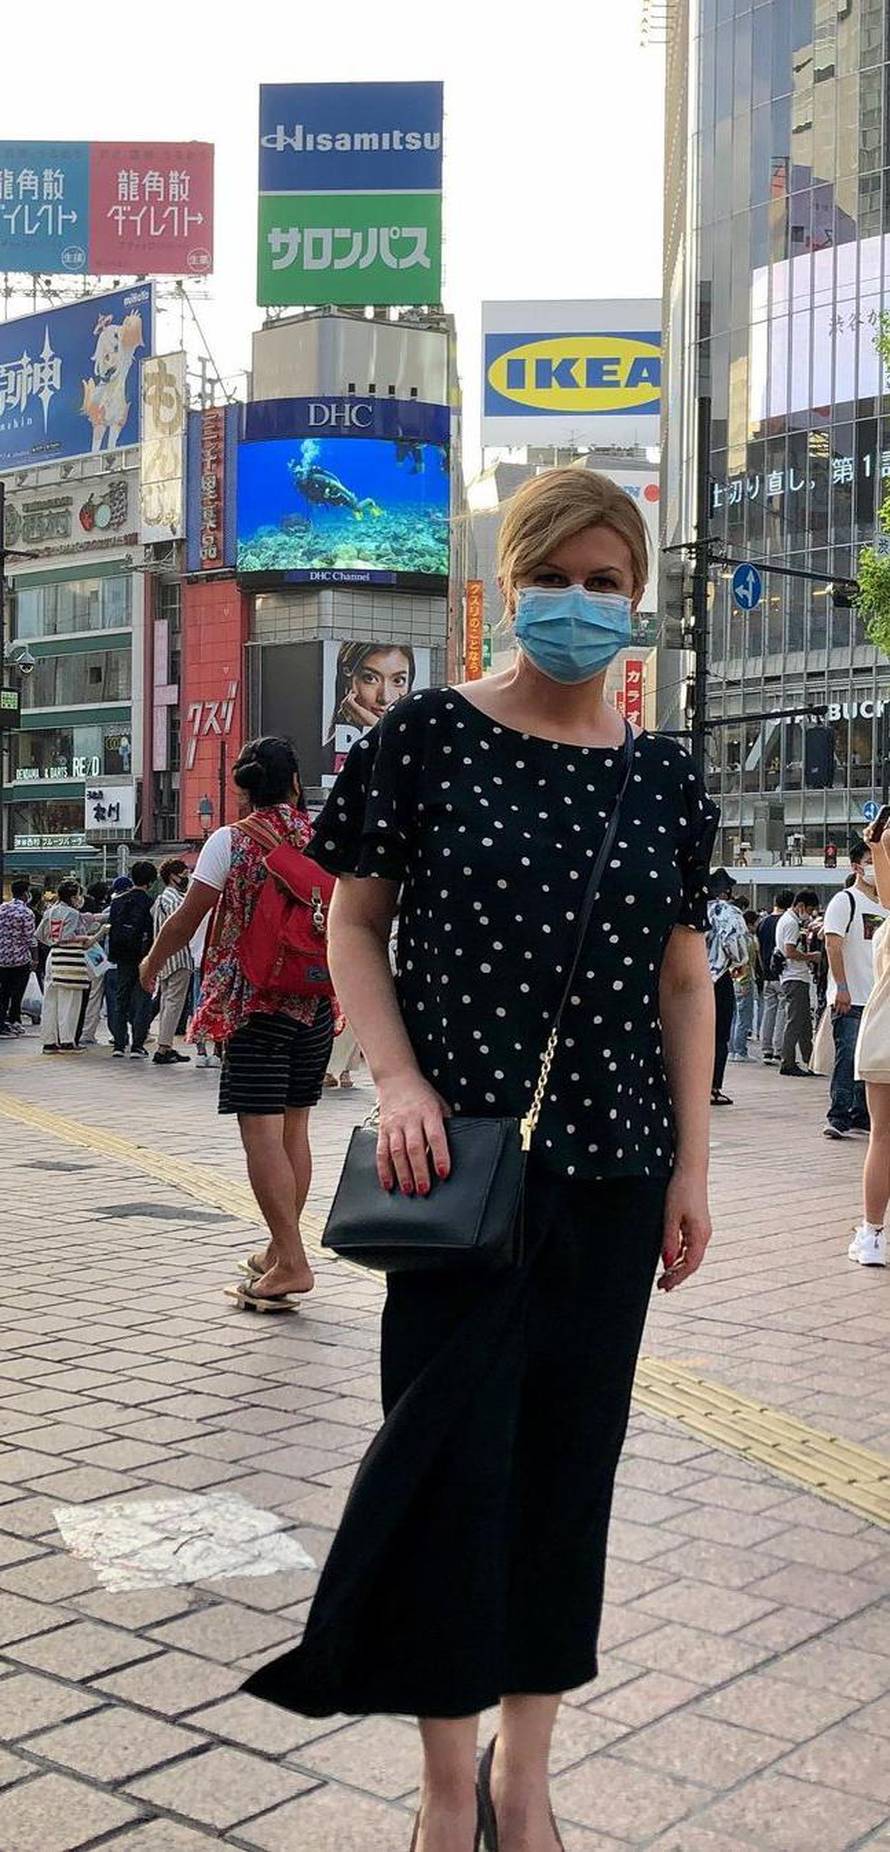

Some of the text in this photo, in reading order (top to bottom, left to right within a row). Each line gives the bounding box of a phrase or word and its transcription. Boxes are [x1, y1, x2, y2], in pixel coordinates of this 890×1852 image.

[261, 125, 441, 151] Hisamitsu
[118, 170, 190, 201] 龍角散
[0, 204, 77, 235] イレクト
[107, 205, 204, 236] ダイレクト
[268, 226, 431, 270] サロンパス
[506, 357, 660, 389] IKEA
[307, 404, 373, 428] DHC
[310, 571, 371, 582] DHC Channel
[185, 680, 240, 772] クスリ
